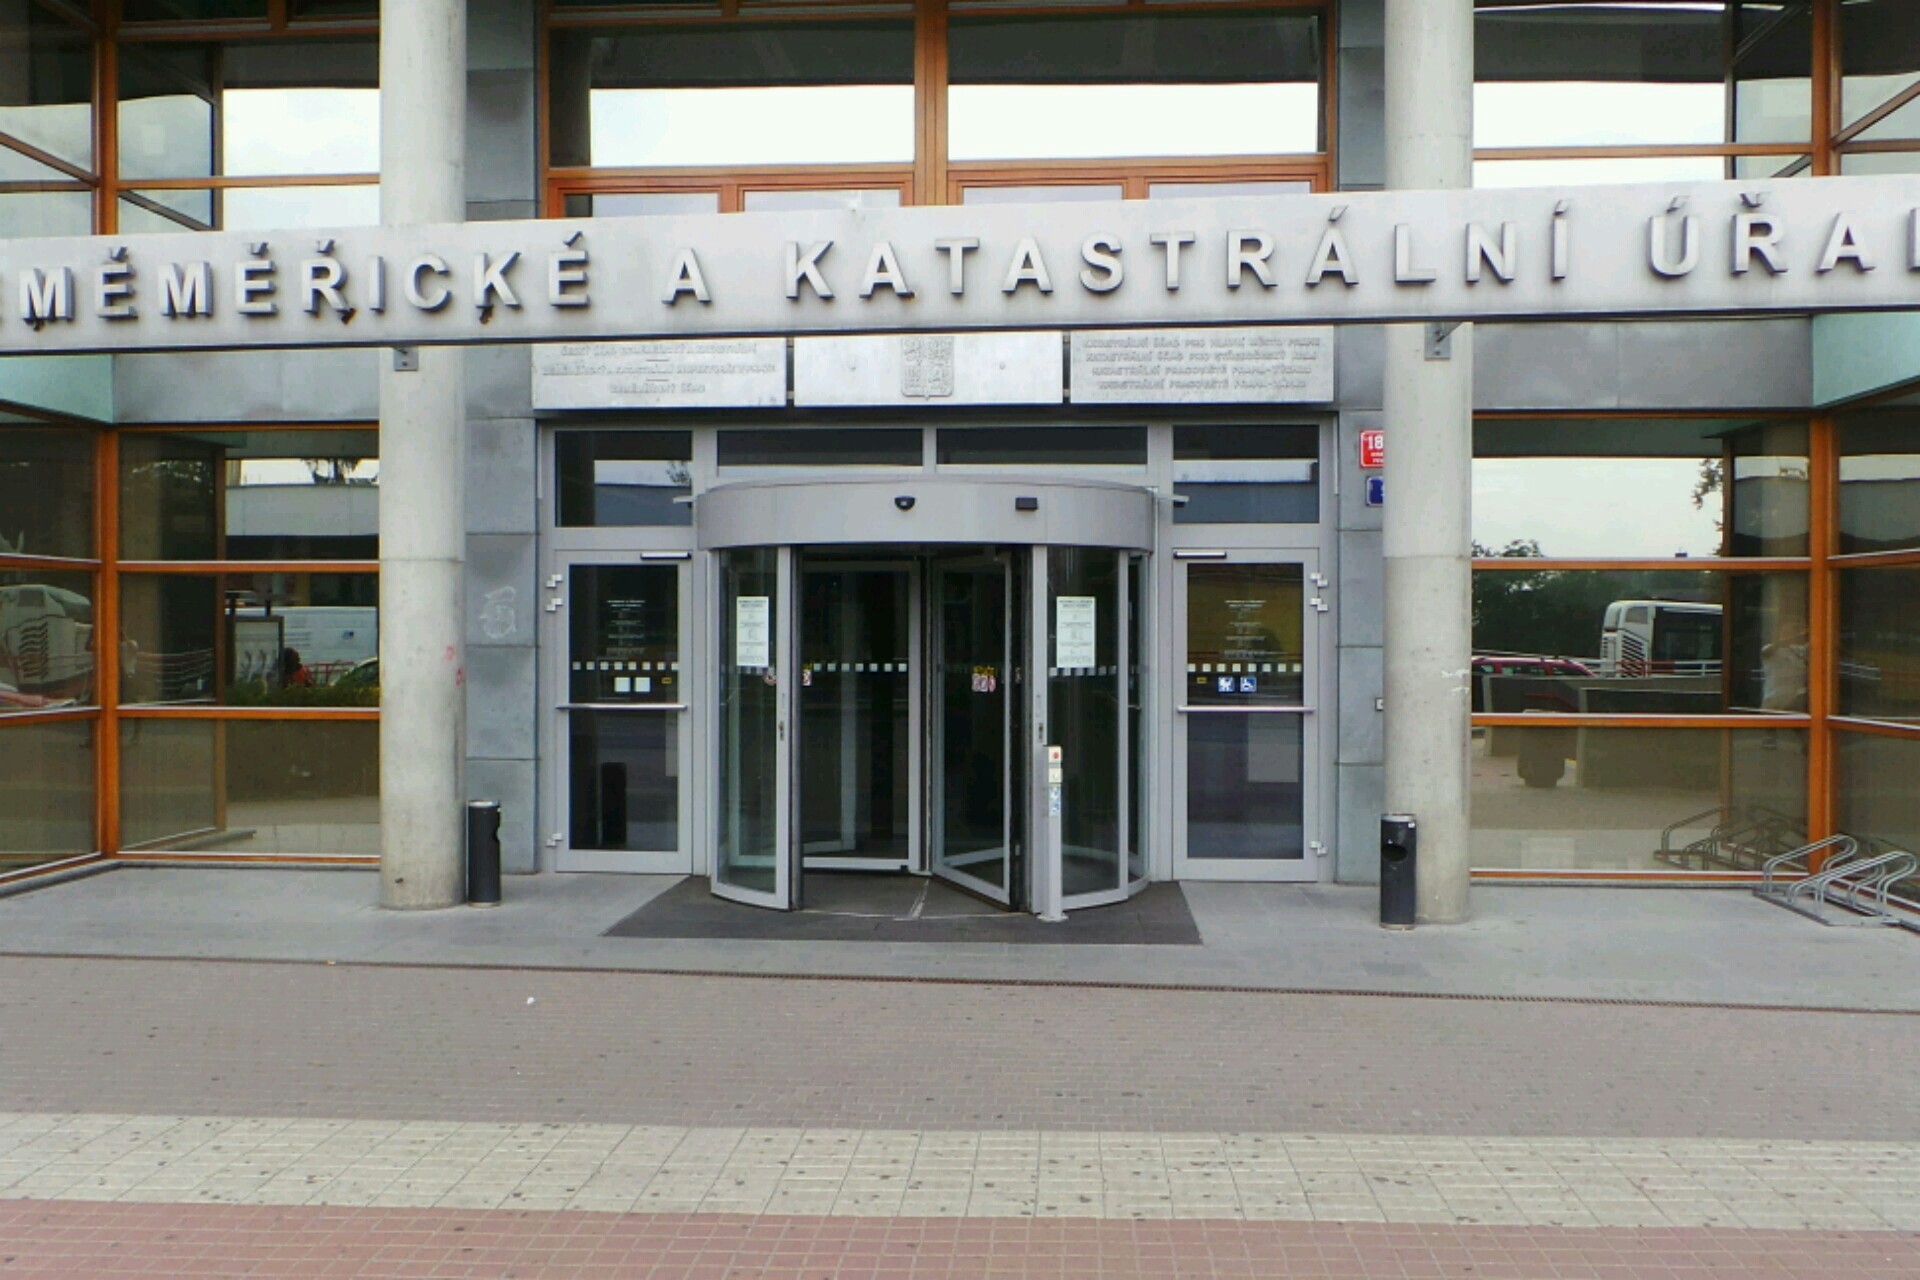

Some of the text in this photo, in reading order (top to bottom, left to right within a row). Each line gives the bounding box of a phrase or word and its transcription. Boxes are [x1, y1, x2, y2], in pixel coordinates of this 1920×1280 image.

[0, 230, 591, 323] MĚMĚŘICKÉ
[662, 247, 712, 303] A
[785, 199, 1570, 300] KATASTRÁLNÍ
[1365, 436, 1384, 449] 18
